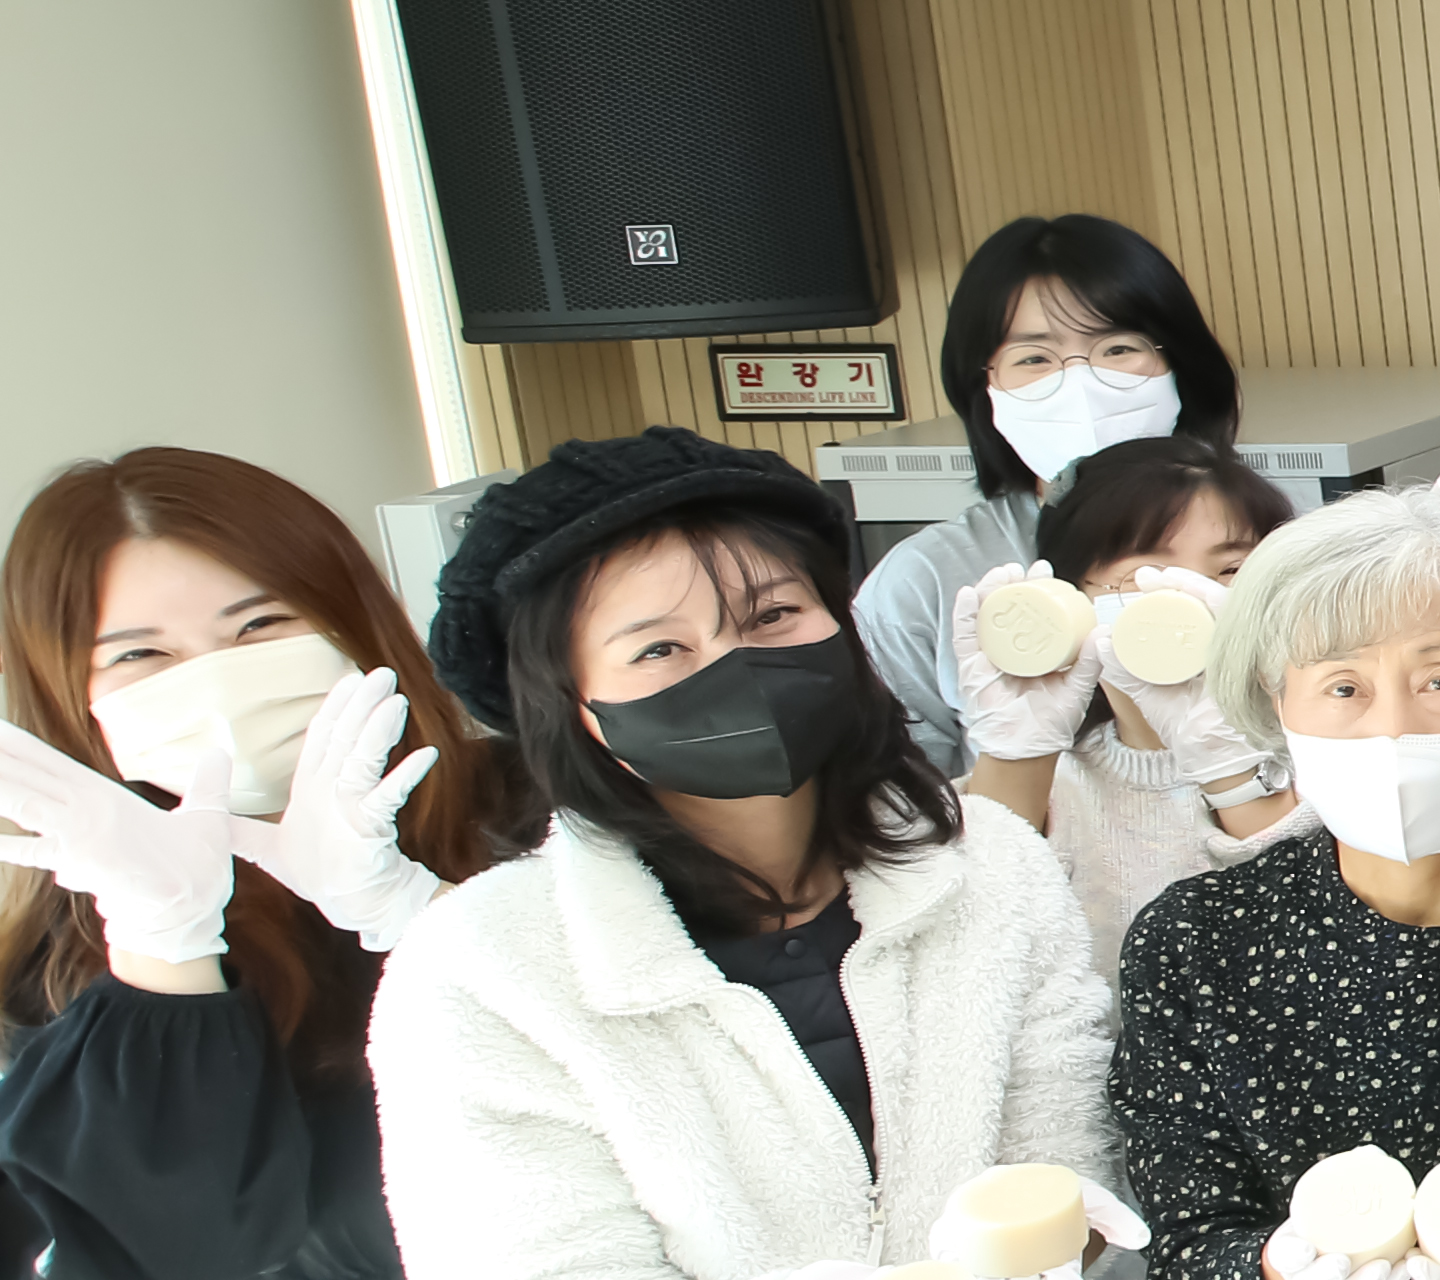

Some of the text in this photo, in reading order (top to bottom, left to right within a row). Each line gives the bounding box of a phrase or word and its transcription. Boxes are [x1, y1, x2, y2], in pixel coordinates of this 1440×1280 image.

[739, 391, 877, 404] DESCENDING LIFE LINE
